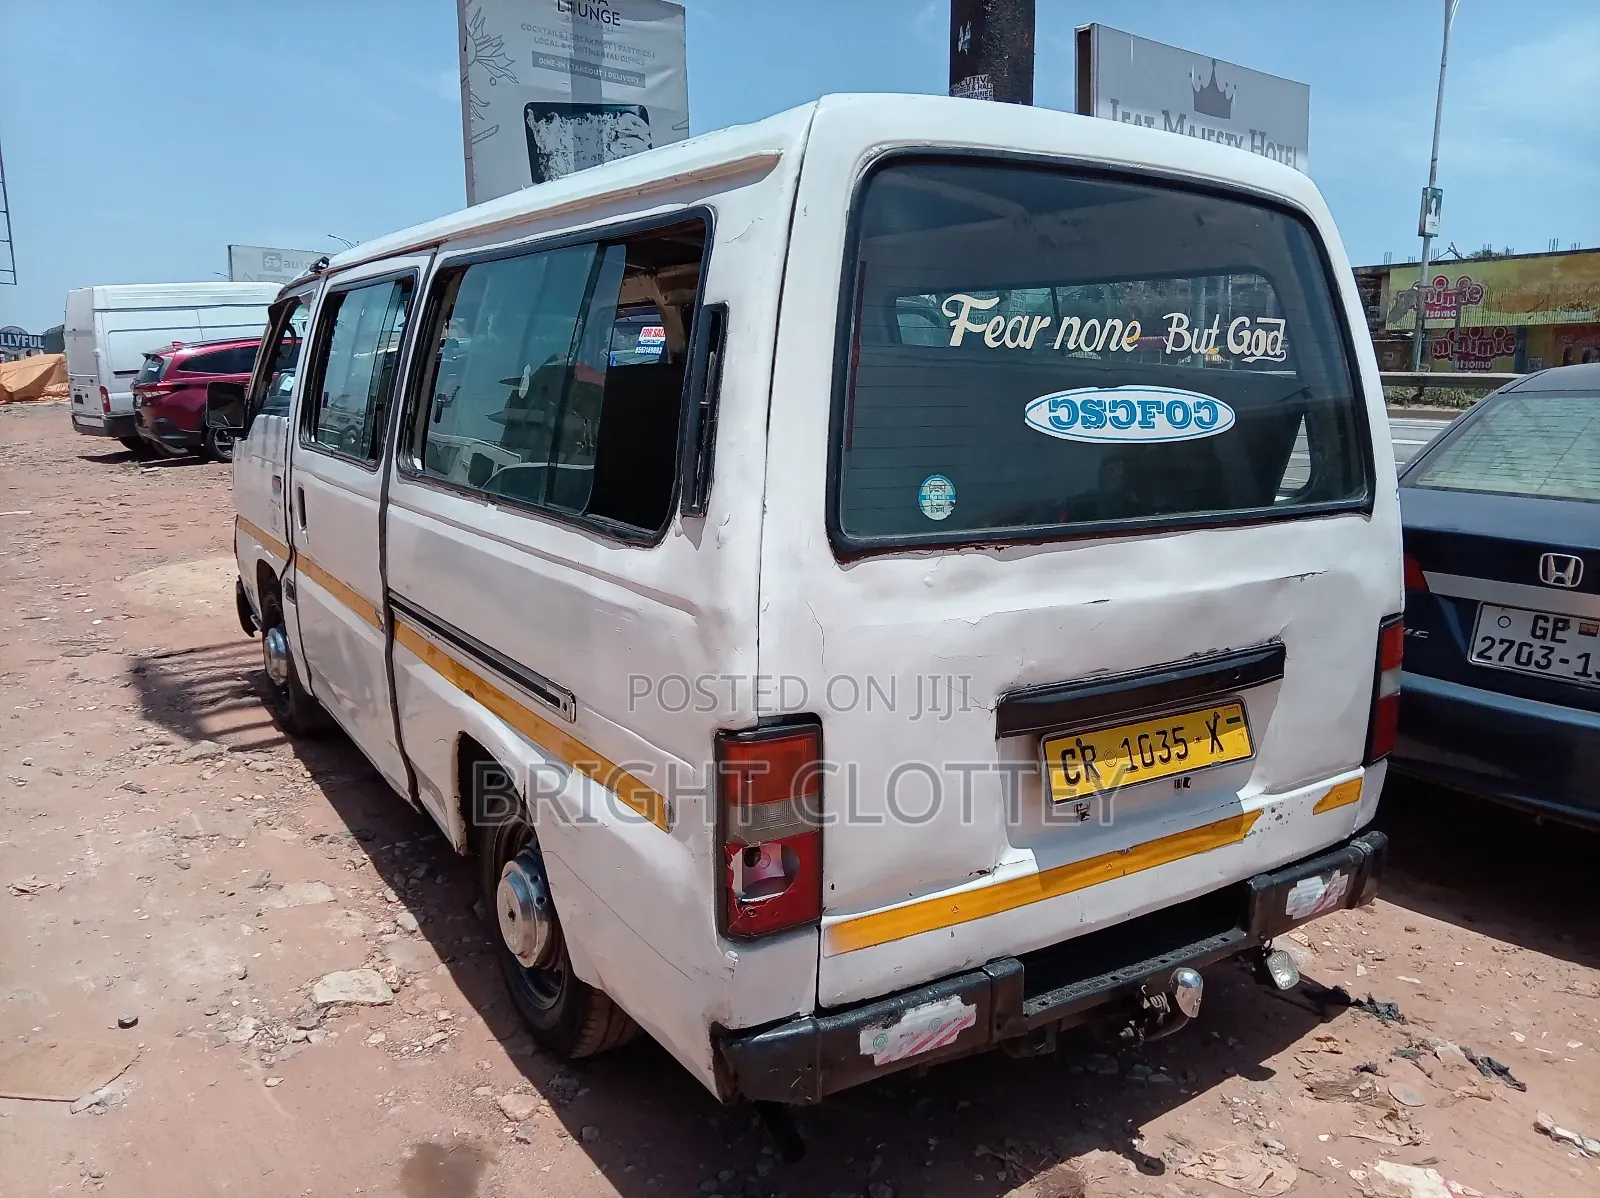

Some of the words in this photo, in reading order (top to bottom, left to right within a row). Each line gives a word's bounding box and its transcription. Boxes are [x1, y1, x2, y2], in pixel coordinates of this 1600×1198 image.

[557, 0, 621, 26] LUNGE
[520, 23, 563, 37] COCKTAILS
[617, 44, 651, 57] PASTRIES
[533, 36, 559, 48] LOCAL
[538, 57, 566, 70] DINE-IN
[571, 64, 603, 77] TAKEOUT
[608, 70, 640, 84] DELIVERY
[641, 328, 653, 338] FOR
[941, 293, 1052, 350] Fear
[1053, 315, 1141, 353] none
[1162, 312, 1220, 355] But
[1227, 316, 1287, 363] God
[1530, 614, 1571, 644] GP
[1060, 740, 1102, 786] CR
